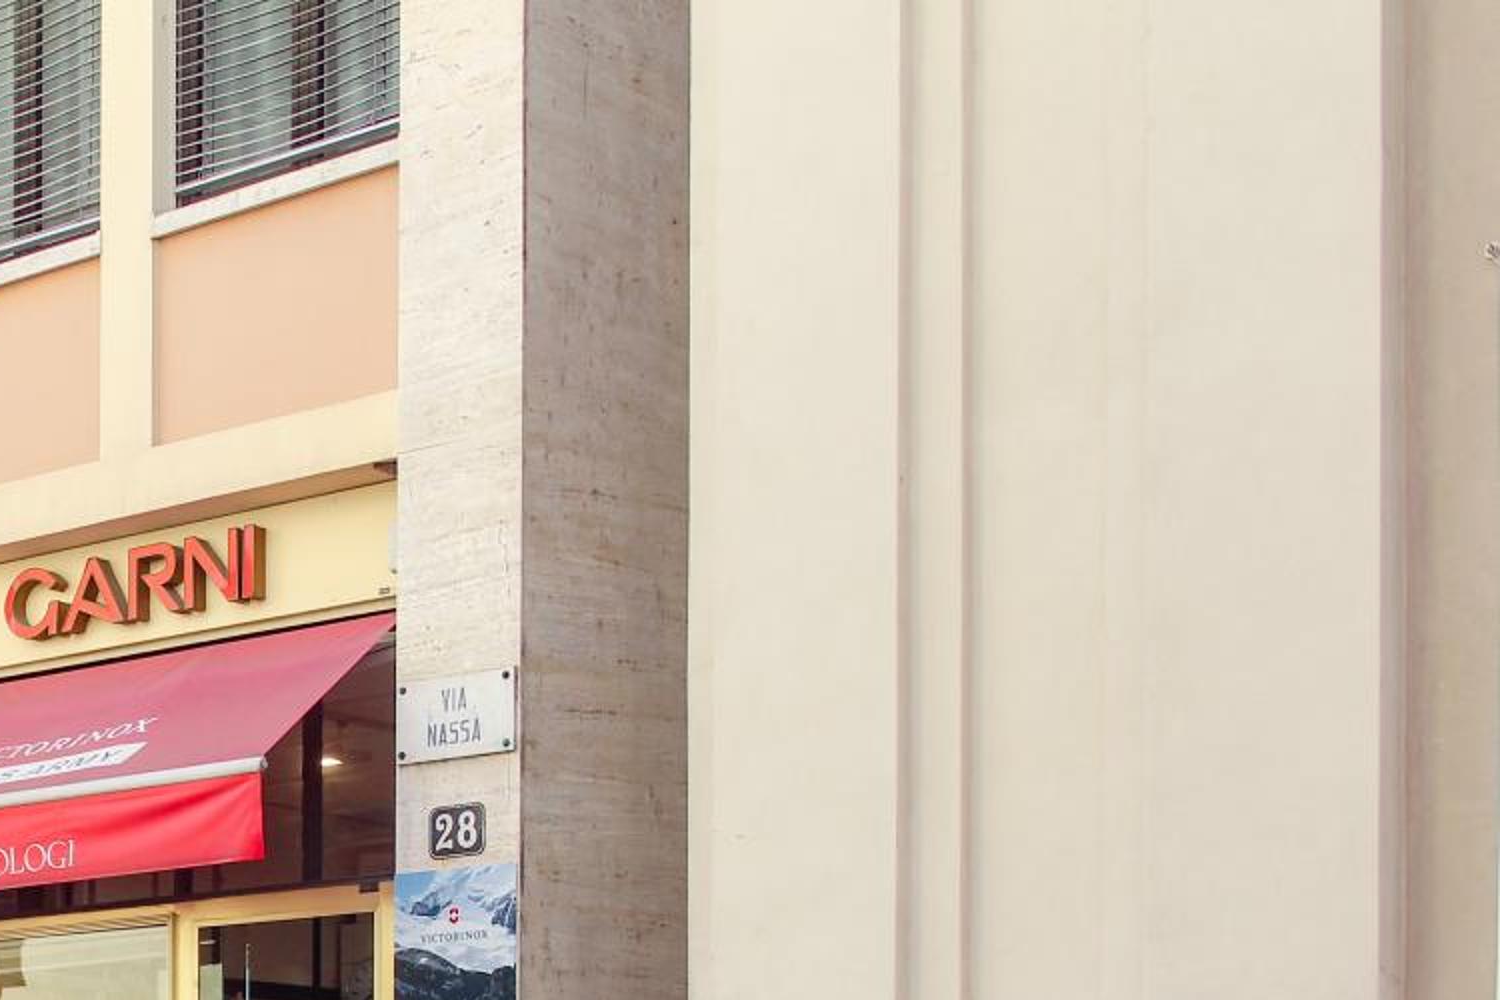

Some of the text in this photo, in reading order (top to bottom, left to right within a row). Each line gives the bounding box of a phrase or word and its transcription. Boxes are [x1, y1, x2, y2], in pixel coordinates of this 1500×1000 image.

[4, 524, 266, 641] GARNI
[441, 687, 467, 711] VIA
[427, 718, 481, 748] NASSA
[25, 748, 123, 776] ARMY
[434, 810, 478, 851] 28
[420, 930, 488, 944] VICTORINOX
